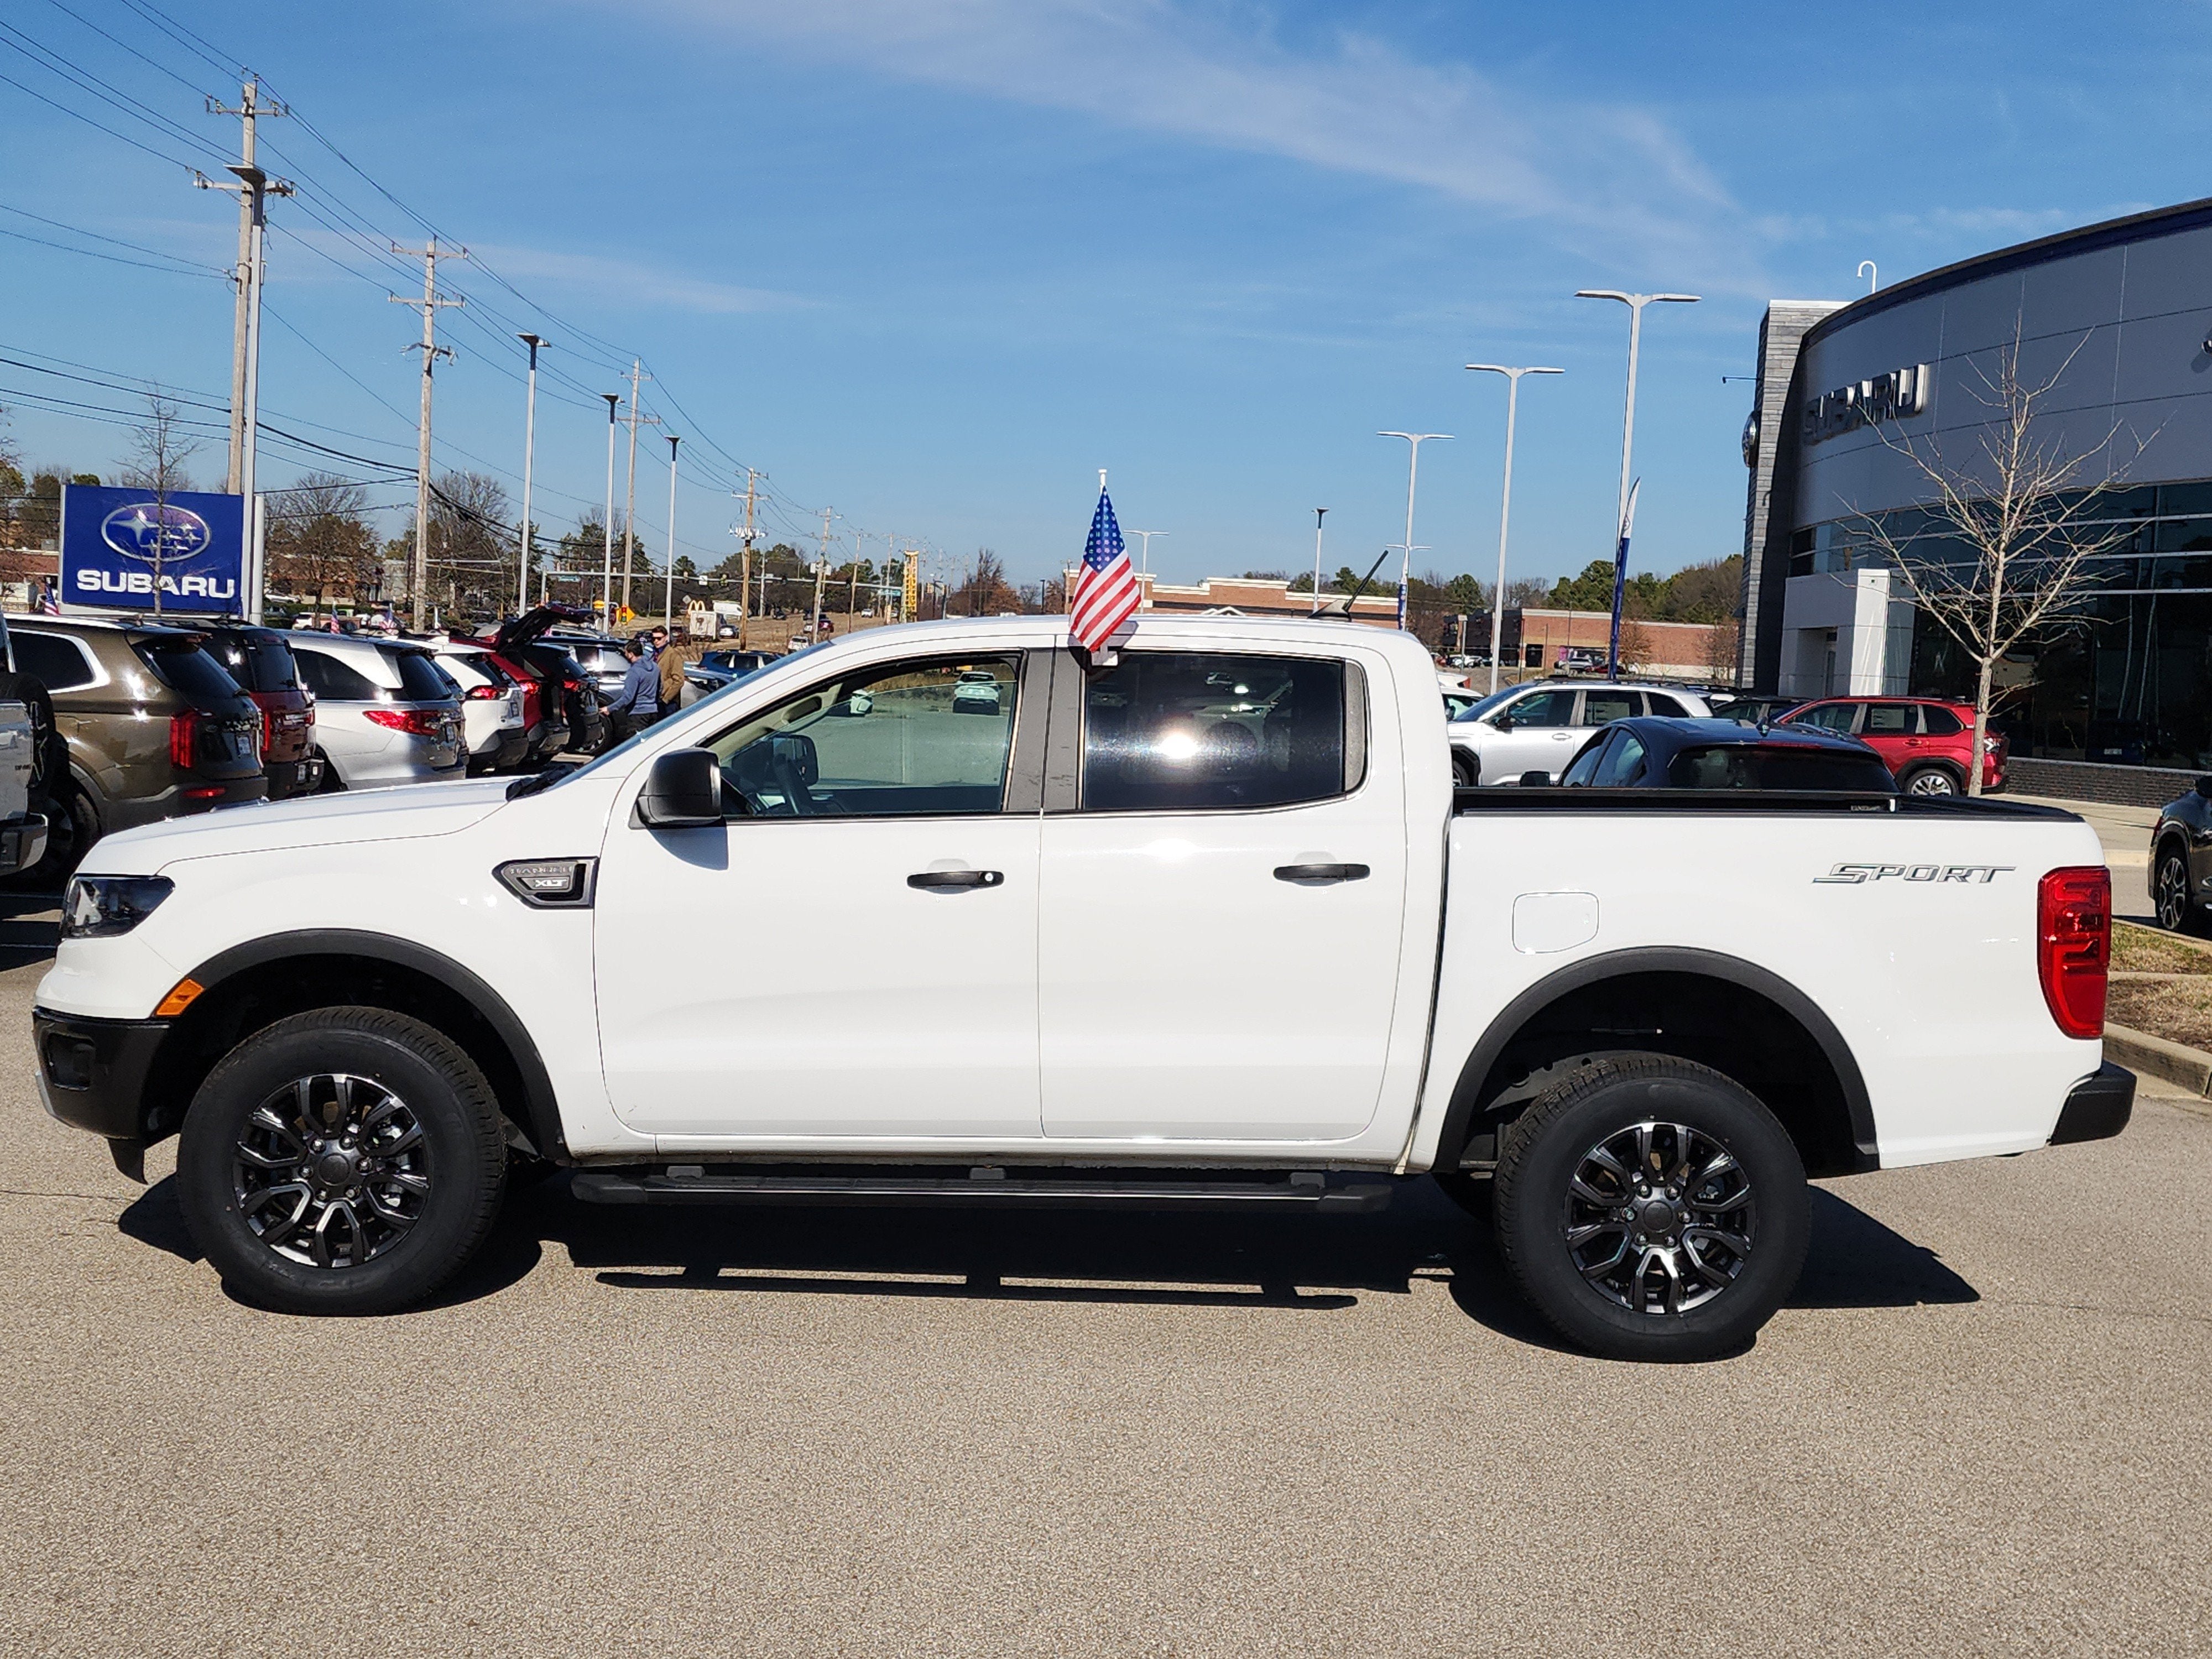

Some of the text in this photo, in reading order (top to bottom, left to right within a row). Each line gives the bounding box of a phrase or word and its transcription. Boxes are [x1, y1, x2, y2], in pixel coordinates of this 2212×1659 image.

[77, 570, 234, 598] SUBARU
[535, 879, 567, 888] XLT
[1812, 863, 2017, 884] SPORT
